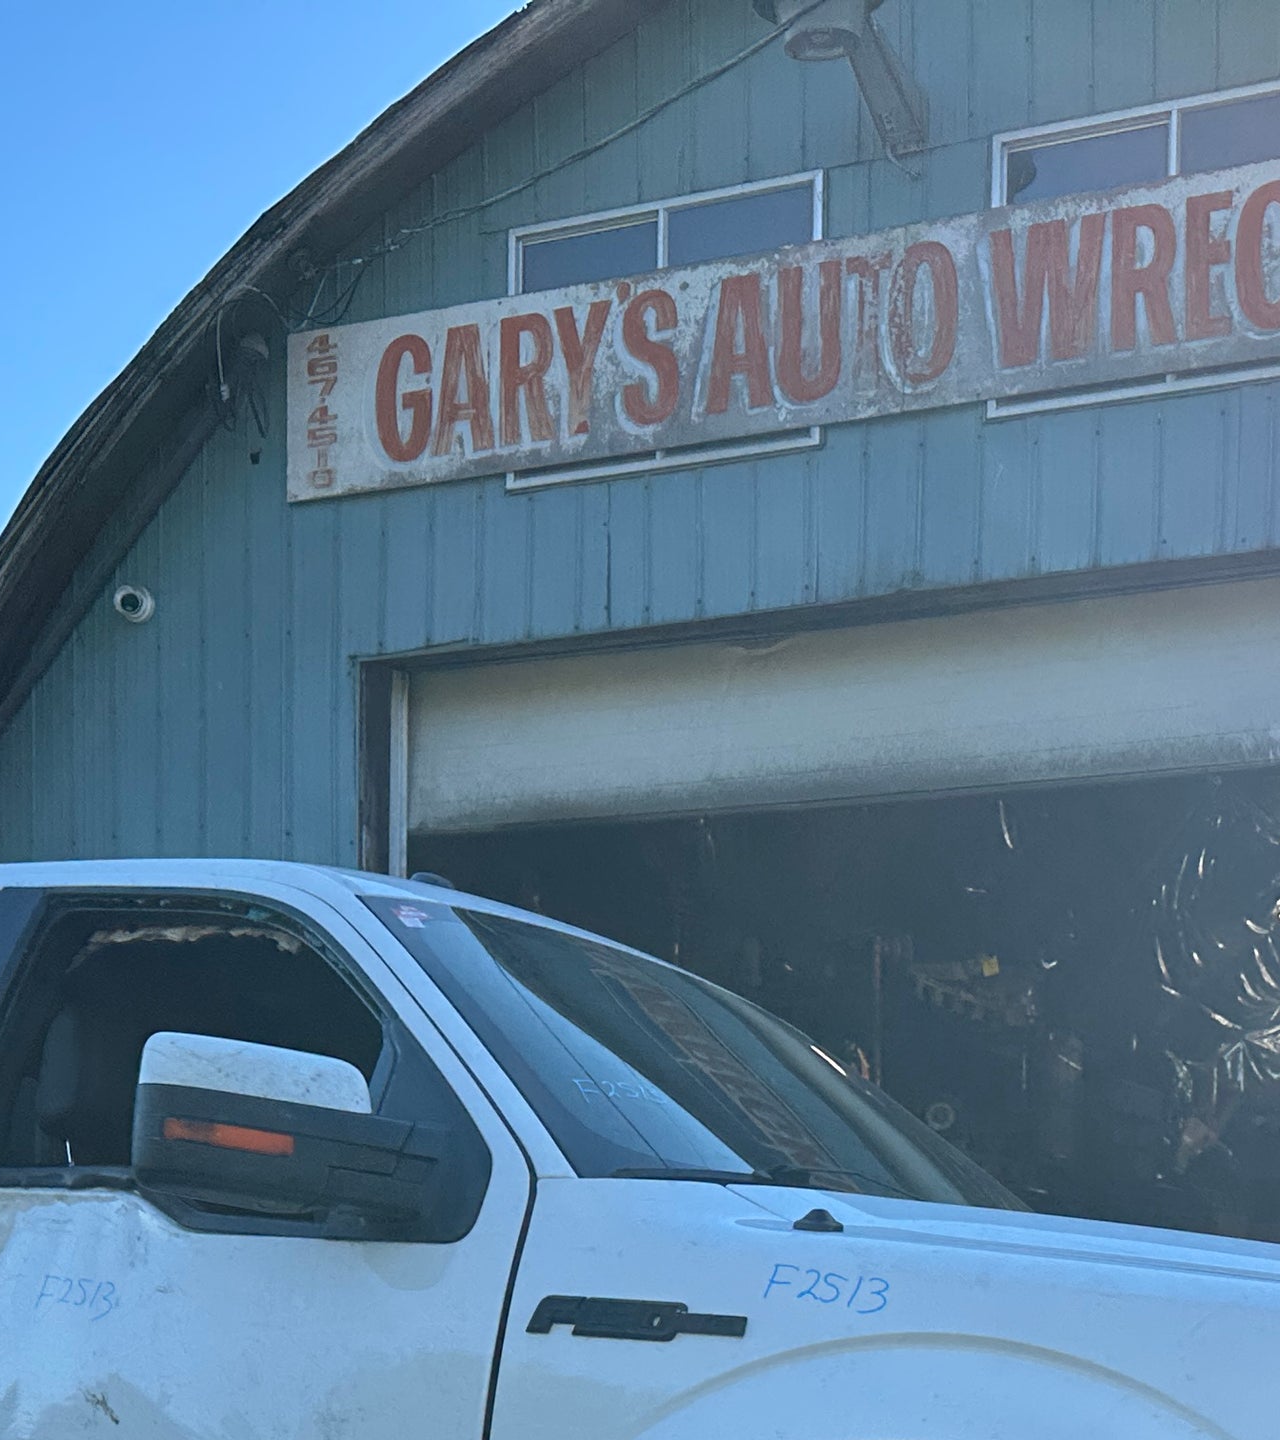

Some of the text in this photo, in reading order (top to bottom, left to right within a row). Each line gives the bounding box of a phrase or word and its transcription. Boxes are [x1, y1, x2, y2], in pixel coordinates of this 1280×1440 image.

[374, 280, 680, 464] GARY'S
[705, 240, 959, 415] AUTO
[35, 1274, 116, 1322] F2513
[763, 1264, 890, 1314] F2513
